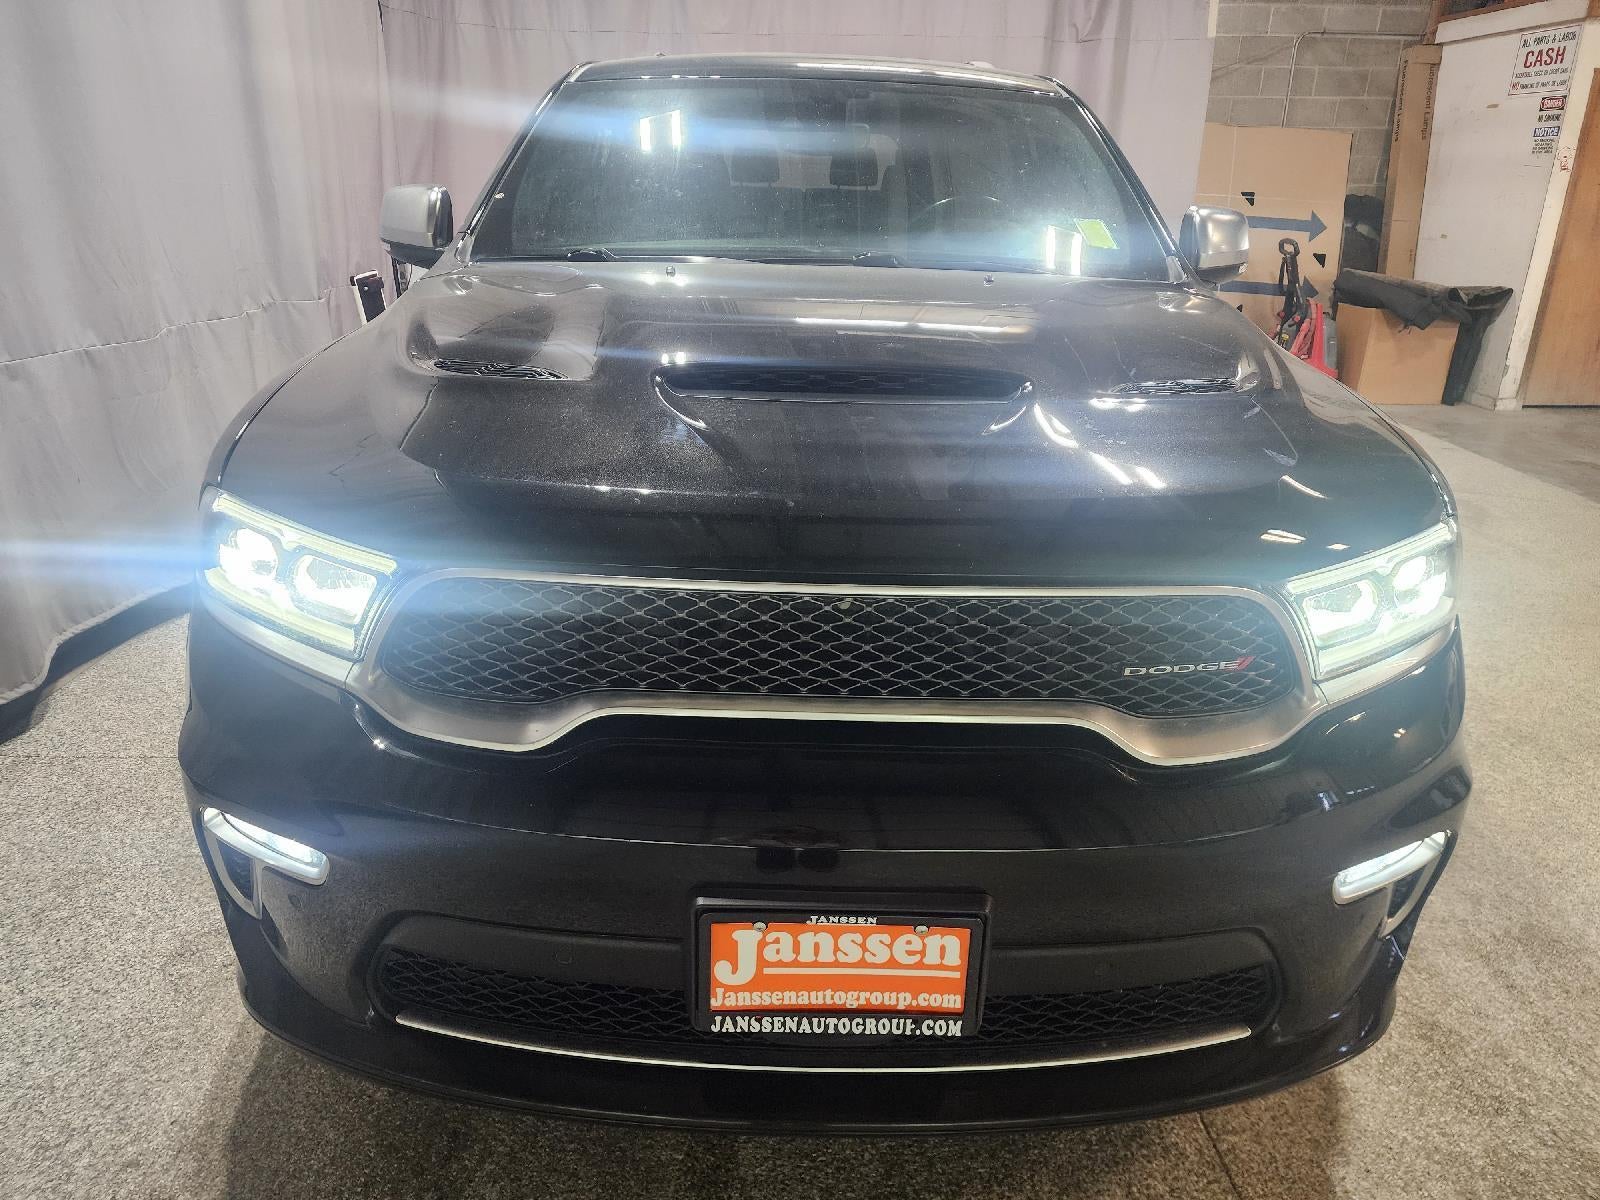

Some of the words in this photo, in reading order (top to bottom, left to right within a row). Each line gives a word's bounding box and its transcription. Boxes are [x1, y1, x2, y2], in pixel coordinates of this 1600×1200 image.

[1522, 39, 1531, 48] ALL
[1534, 35, 1550, 46] PARTS
[1558, 31, 1577, 42] LABOR
[1524, 46, 1566, 68] CASH
[1421, 112, 1431, 141] Lamps
[1534, 127, 1559, 137] NOTICE
[1124, 660, 1240, 676] DODGE
[806, 915, 878, 925] JANSSEN
[713, 929, 962, 986] Janssen
[710, 987, 962, 1010] Janssenautogroup.com
